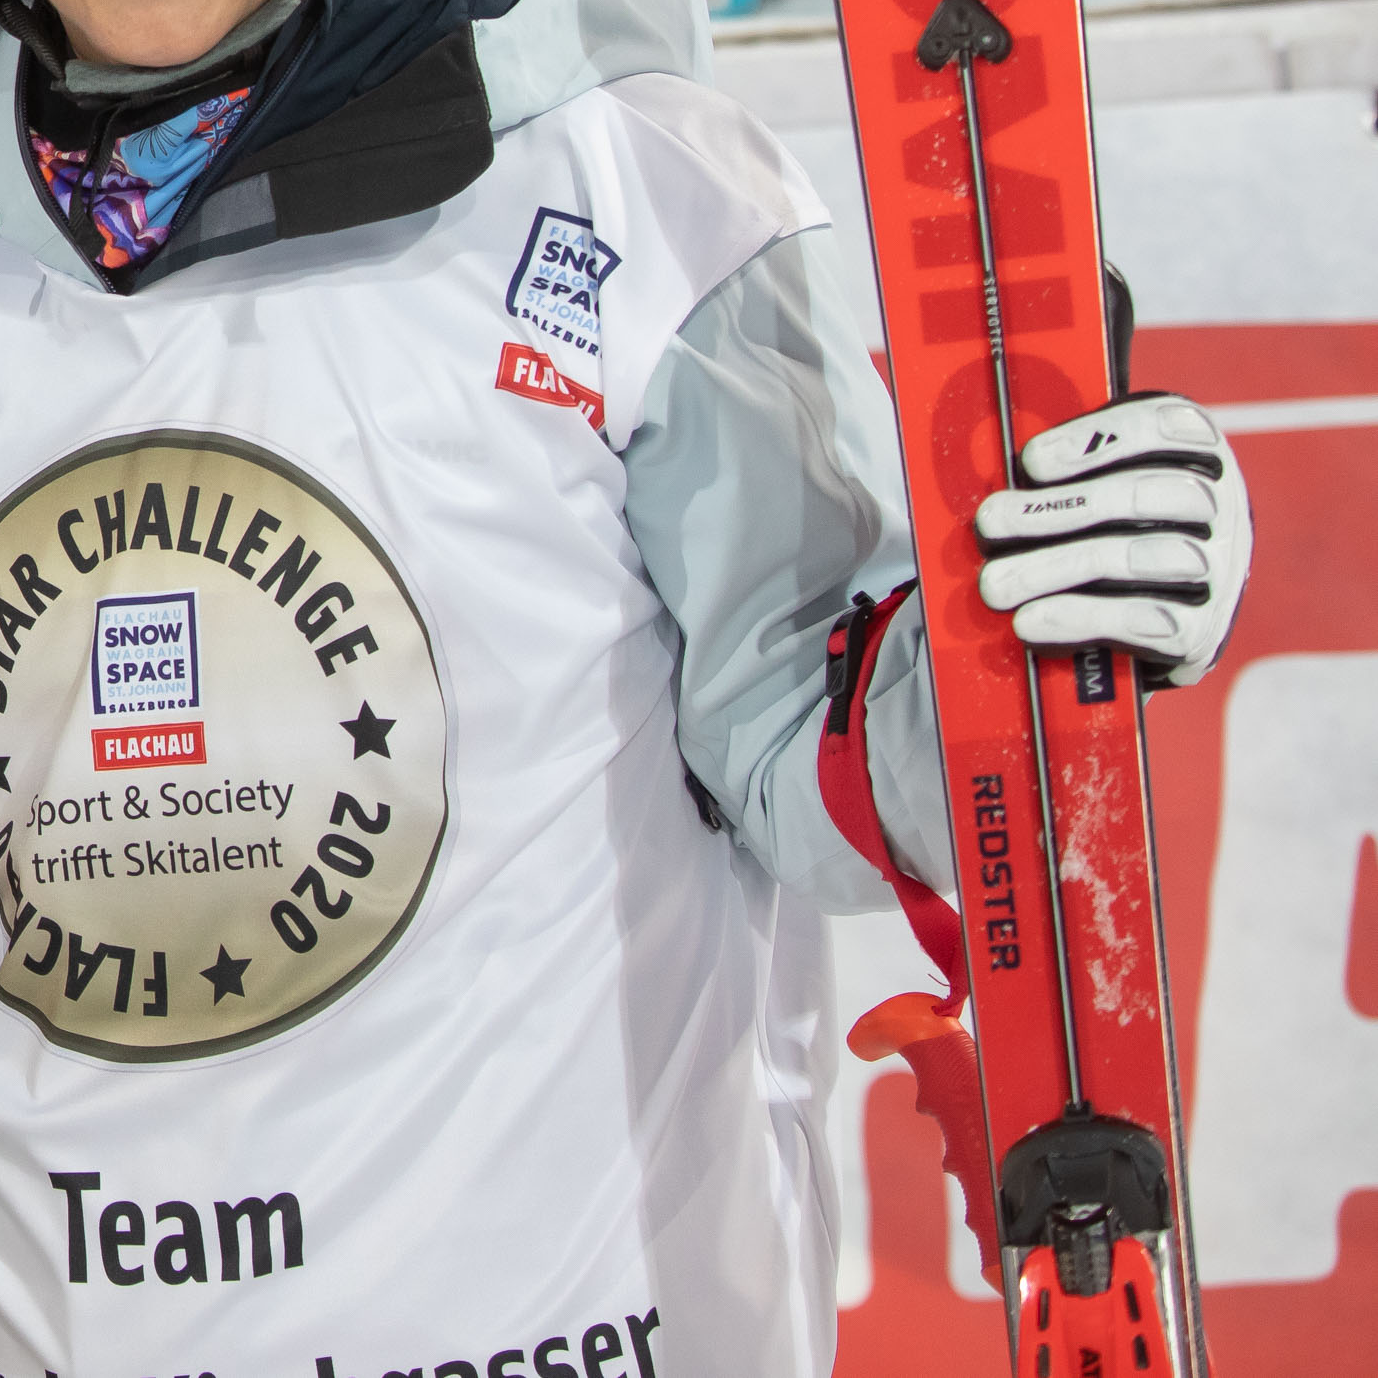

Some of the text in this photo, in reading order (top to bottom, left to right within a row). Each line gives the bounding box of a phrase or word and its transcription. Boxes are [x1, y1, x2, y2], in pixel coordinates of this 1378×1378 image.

[525, 290, 546, 308] ST.
[530, 277, 600, 318] SPA
[983, 277, 1004, 358] SERVOTEC
[521, 308, 602, 359] SALZBUR
[56, 482, 380, 678] CHALLENGE
[105, 622, 182, 648] SNOW
[106, 645, 184, 662] WAGRAIN
[107, 659, 186, 684] SPACE
[129, 682, 187, 696] JOHANN
[109, 699, 187, 713] SALZBURG
[105, 732, 194, 761] FLACHAU
[123, 785, 150, 819] &
[159, 779, 294, 820] Society
[32, 837, 283, 884] trifft Skitalent
[269, 791, 392, 955] 2020
[971, 774, 1021, 973] REDSTER
[47, 1171, 304, 1286] Team
